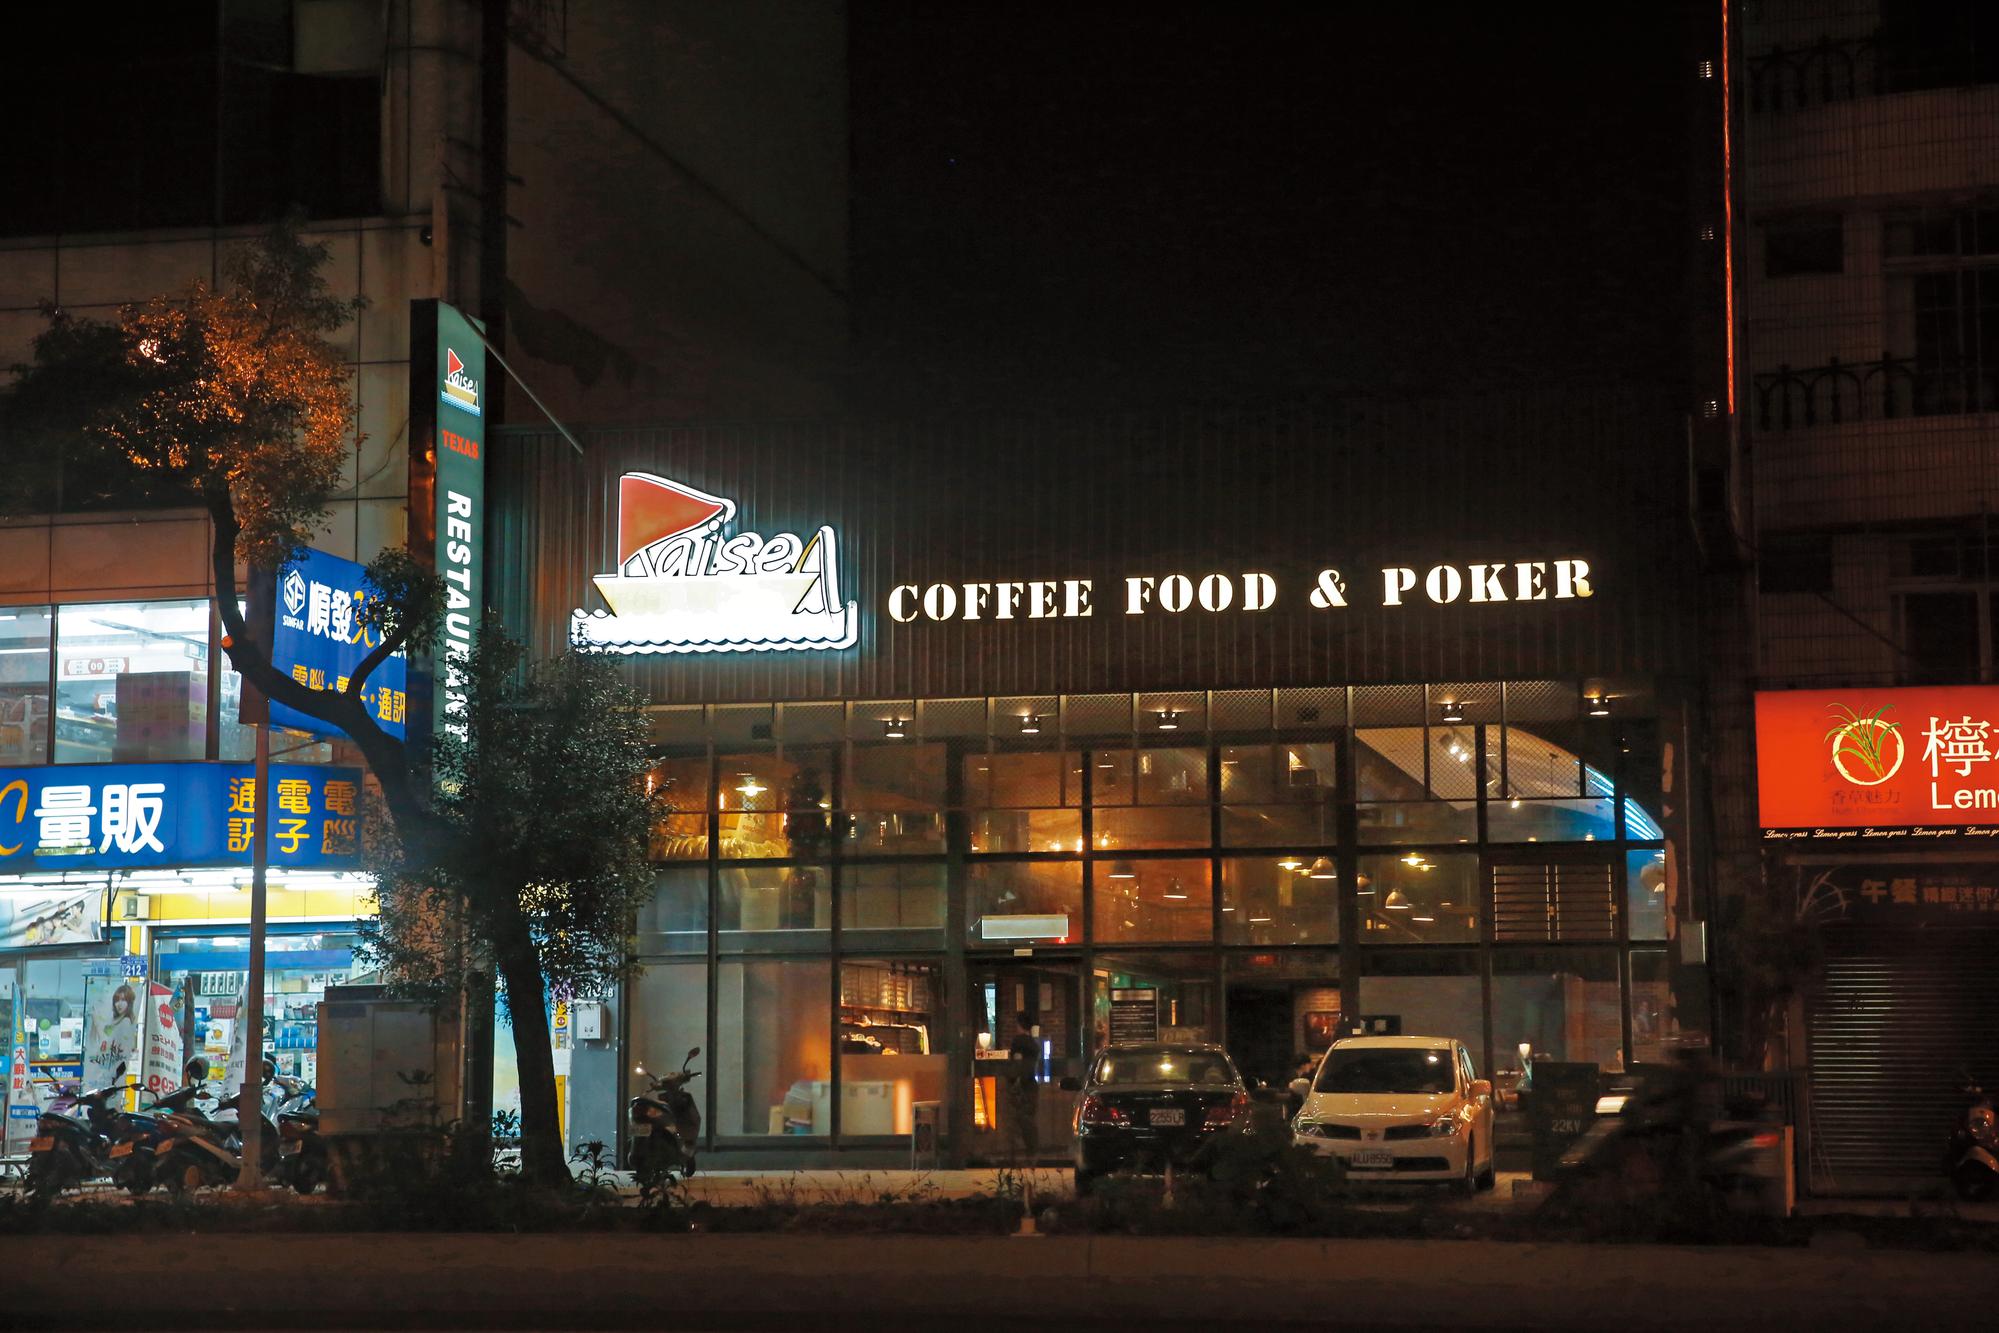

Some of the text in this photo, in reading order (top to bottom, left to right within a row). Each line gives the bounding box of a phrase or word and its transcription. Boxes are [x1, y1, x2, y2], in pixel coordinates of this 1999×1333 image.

[442, 430, 479, 460] TEXAS
[888, 559, 1594, 623] COFFEE FOOD & POKER
[282, 614, 305, 631] SUNFAR
[445, 490, 471, 743] RESTAURANT
[1921, 715, 1999, 778] 檸
[275, 779, 312, 854] 電子
[1931, 782, 1999, 809] Lem
[125, 964, 142, 976] 212
